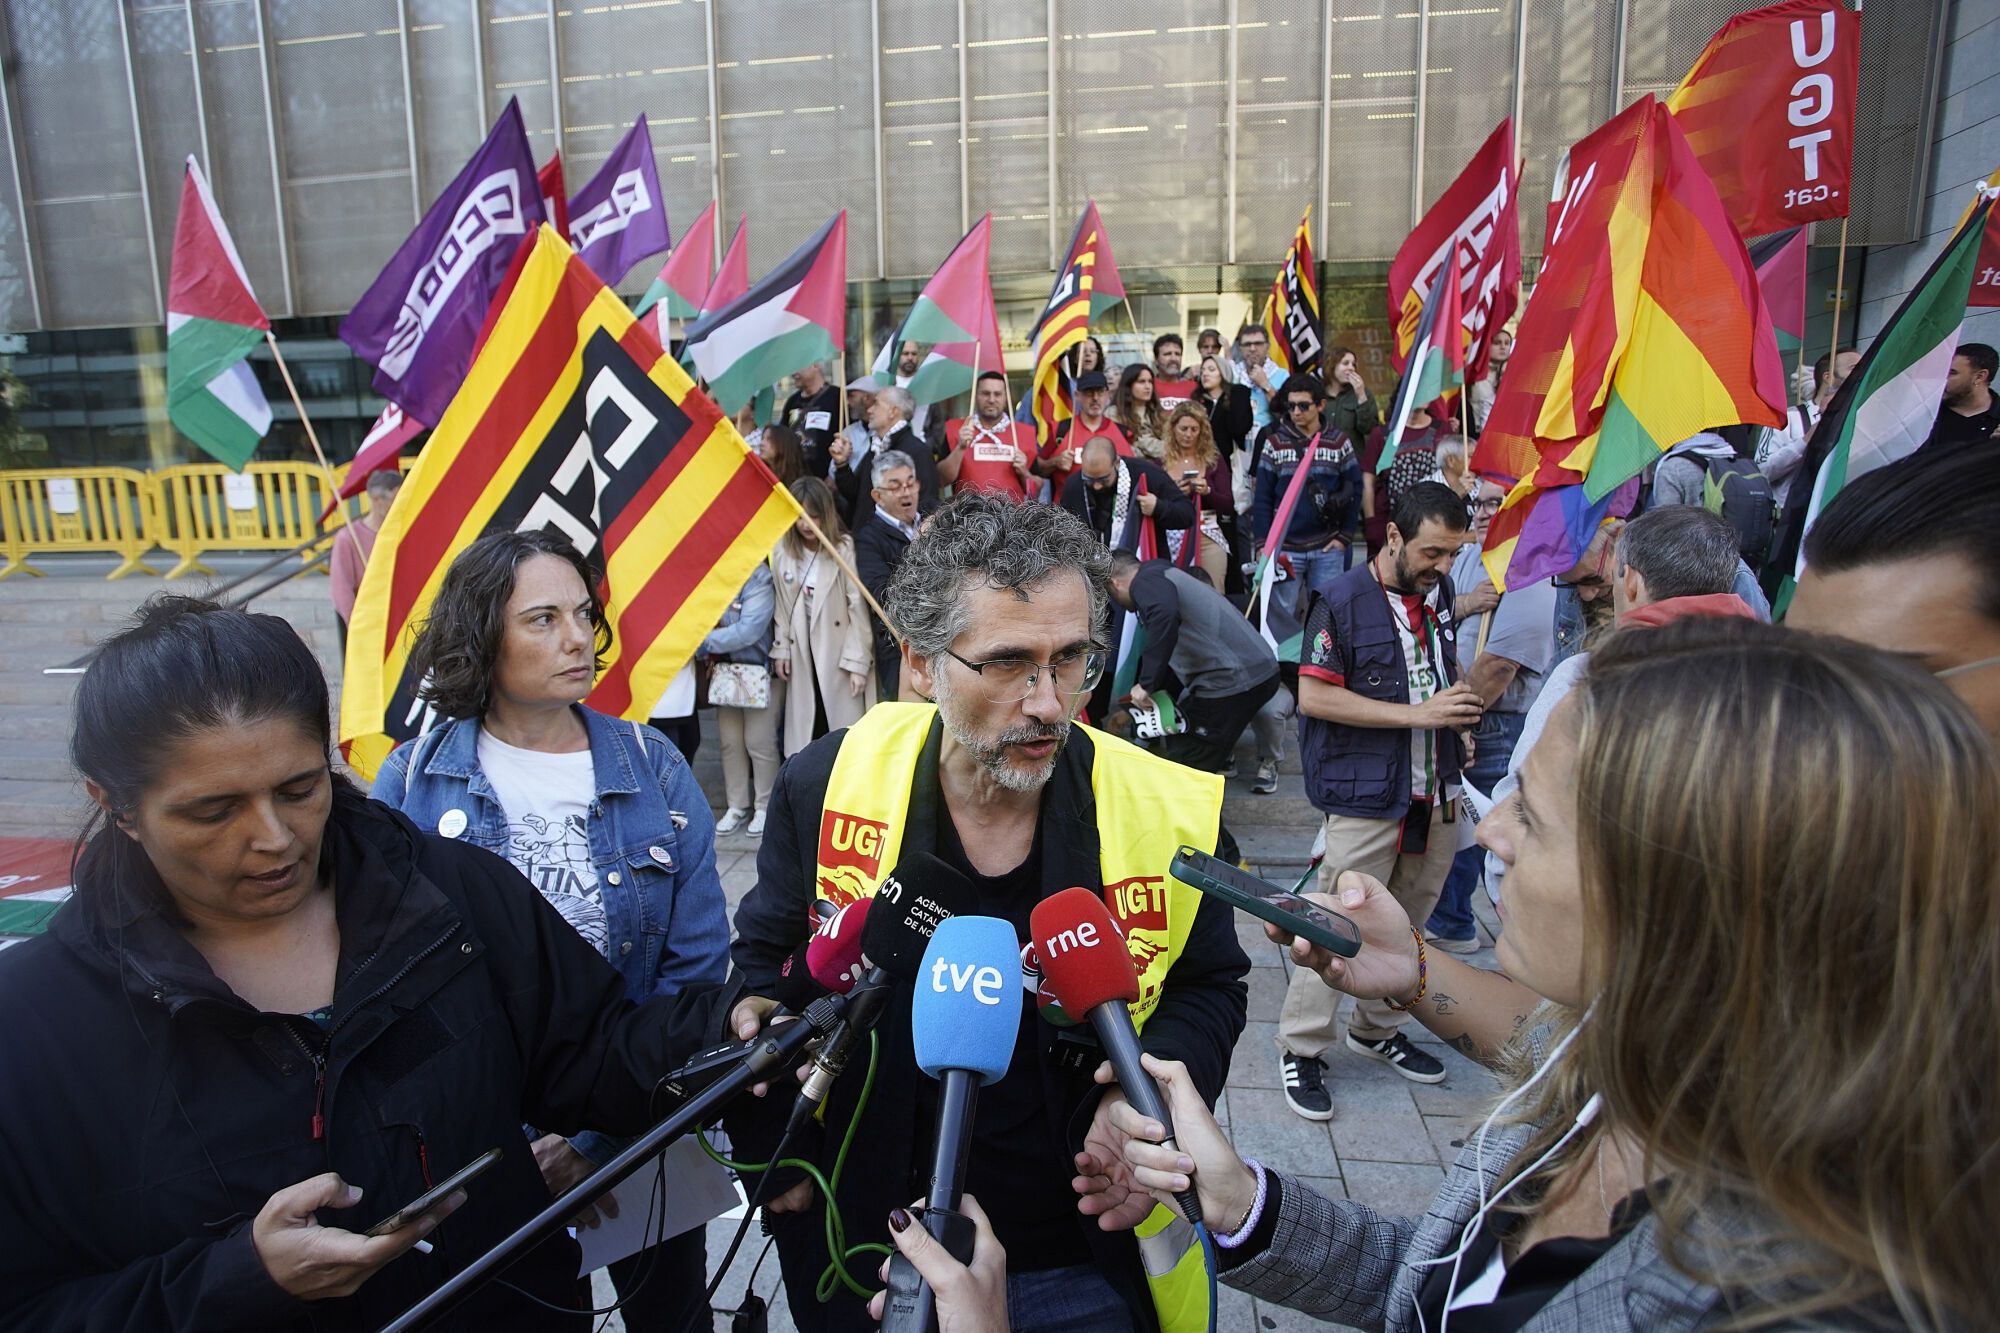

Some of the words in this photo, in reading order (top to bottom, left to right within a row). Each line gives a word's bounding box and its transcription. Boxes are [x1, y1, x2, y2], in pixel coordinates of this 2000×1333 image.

[879, 875, 903, 905] cn
[1114, 881, 1166, 920] UGT
[904, 917, 917, 930] DE
[1046, 922, 1101, 959] rne
[931, 956, 1003, 1005] tve
